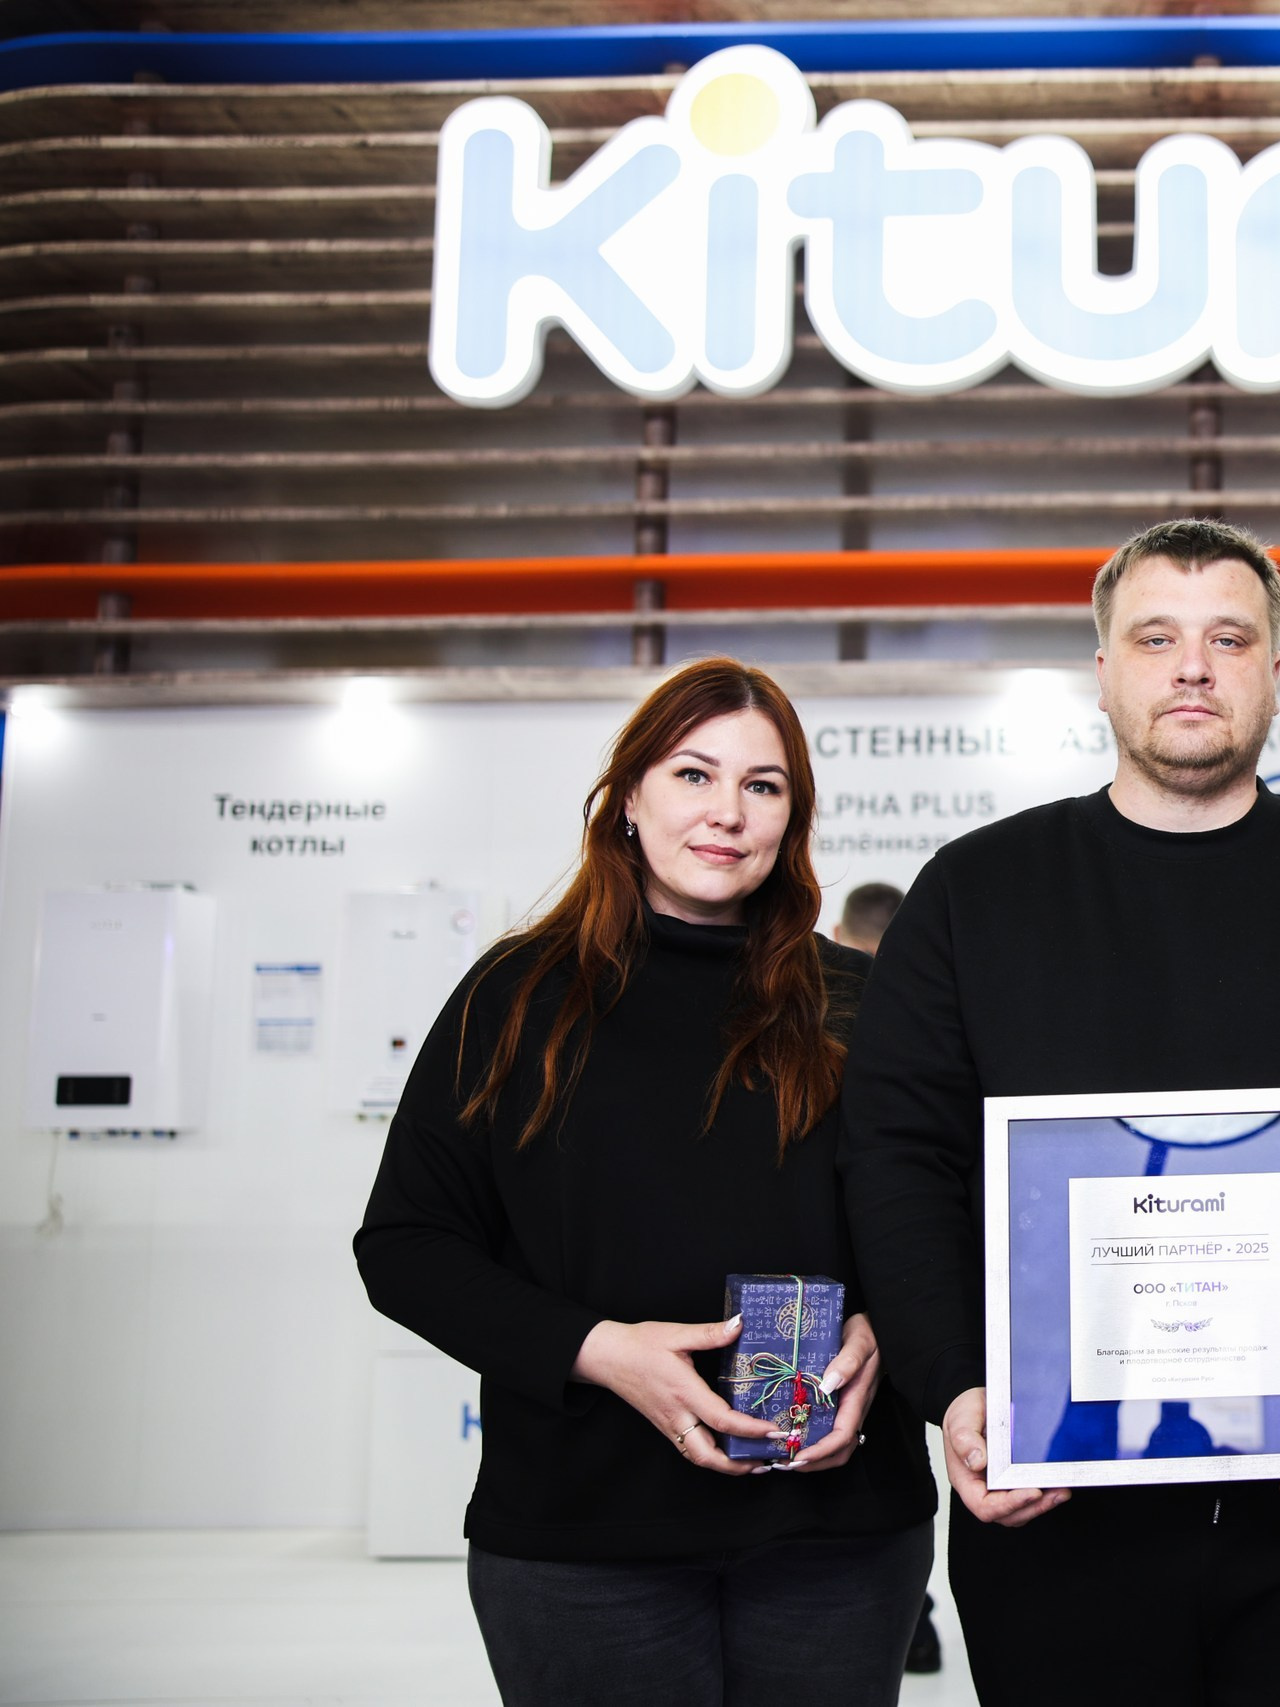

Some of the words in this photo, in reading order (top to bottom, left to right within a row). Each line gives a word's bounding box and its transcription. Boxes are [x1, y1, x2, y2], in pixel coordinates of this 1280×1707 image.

[213, 793, 387, 825] Тендерные
[910, 791, 995, 820] PLUS
[251, 835, 346, 857] котлы
[1133, 1192, 1226, 1214] Kiturami
[1091, 1243, 1155, 1258] ЛУЧШИЙ
[1158, 1242, 1223, 1257] ПАРТНЁР
[1235, 1242, 1270, 1254] 2025
[1133, 1283, 1166, 1295] ООО
[1169, 1281, 1229, 1294] «ТИТАН»
[1096, 1348, 1145, 1358] Благодарим
[1157, 1346, 1191, 1355] высокие
[1126, 1356, 1183, 1366] плодотворное
